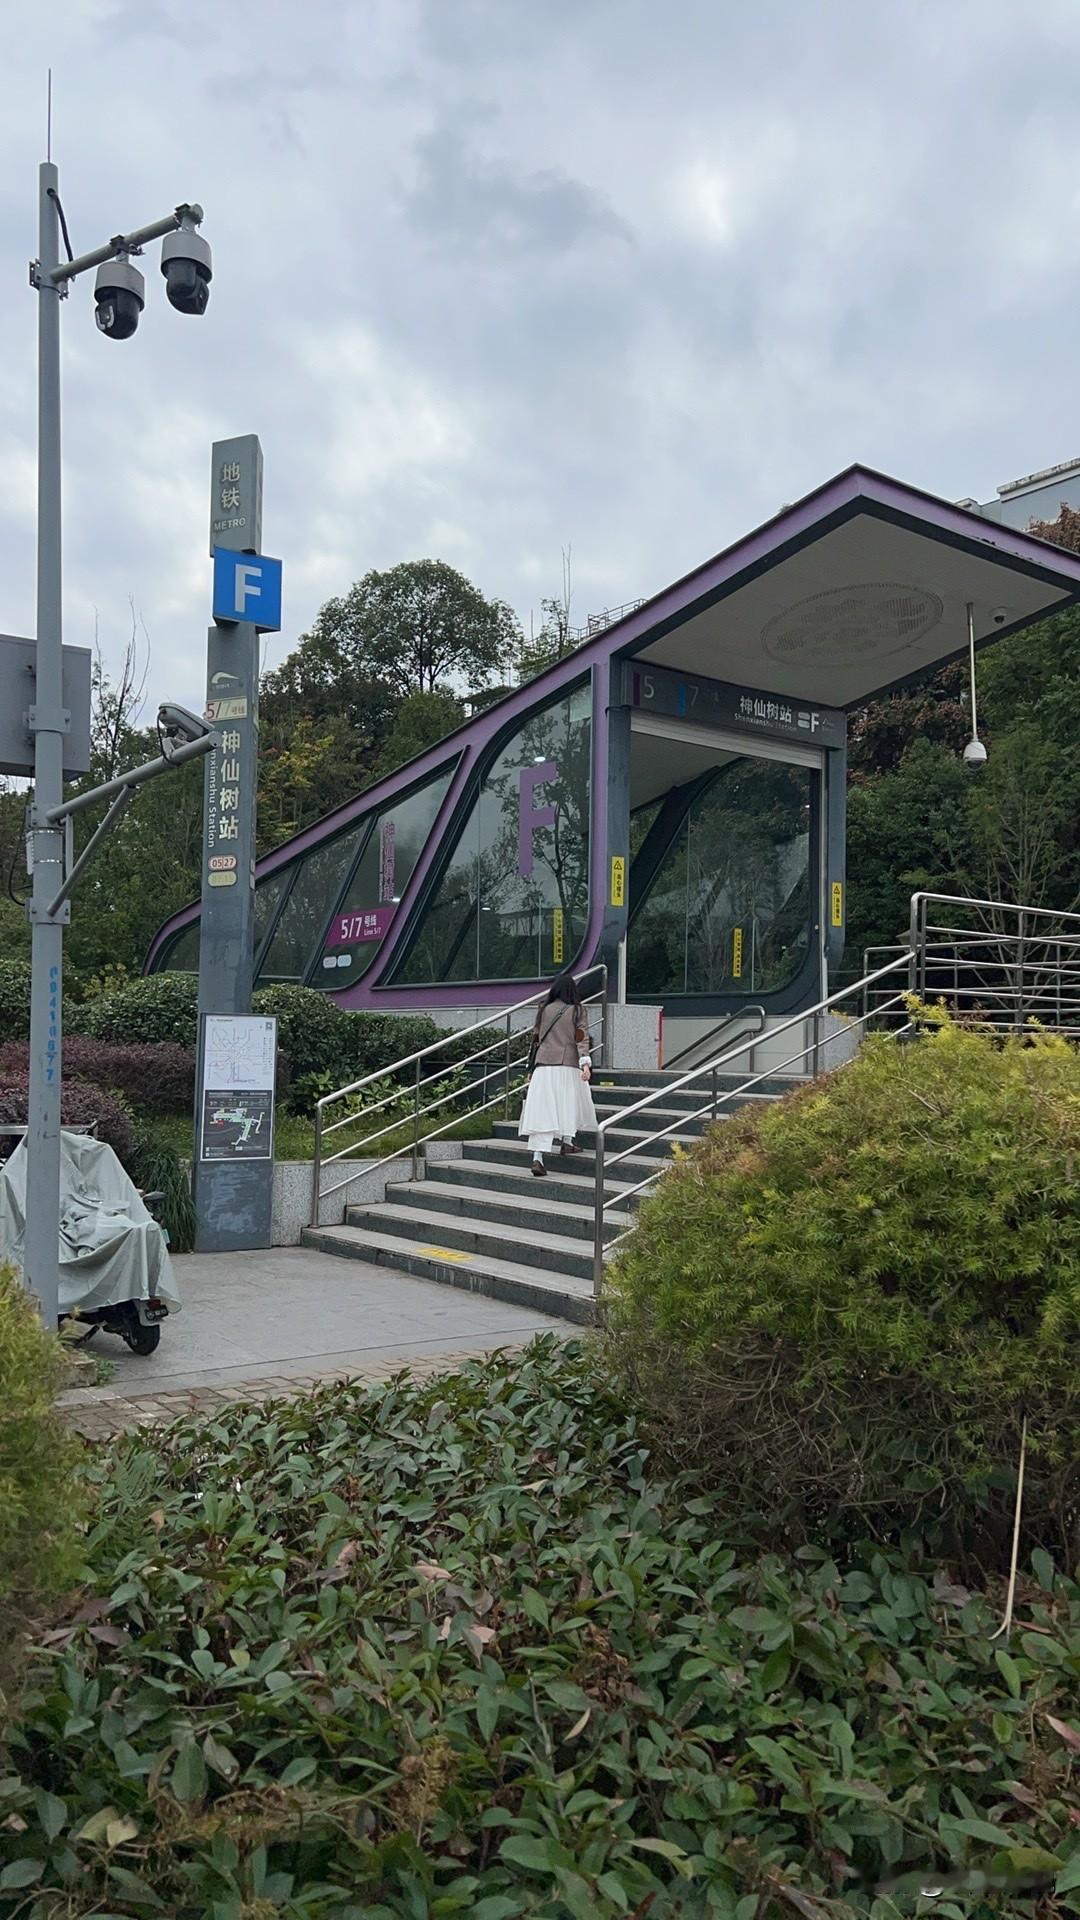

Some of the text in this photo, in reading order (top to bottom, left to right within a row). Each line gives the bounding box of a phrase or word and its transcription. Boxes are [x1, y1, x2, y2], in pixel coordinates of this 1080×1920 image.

[221, 463, 241, 509] 地铁
[213, 517, 246, 531] METRO
[234, 563, 263, 613] F
[643, 675, 655, 699] 5
[688, 685, 699, 707] 7
[739, 695, 793, 723] 神仙树站
[810, 712, 820, 733] F
[218, 730, 241, 840] 神仙树站
[207, 806, 218, 848] Station
[518, 762, 558, 876] F
